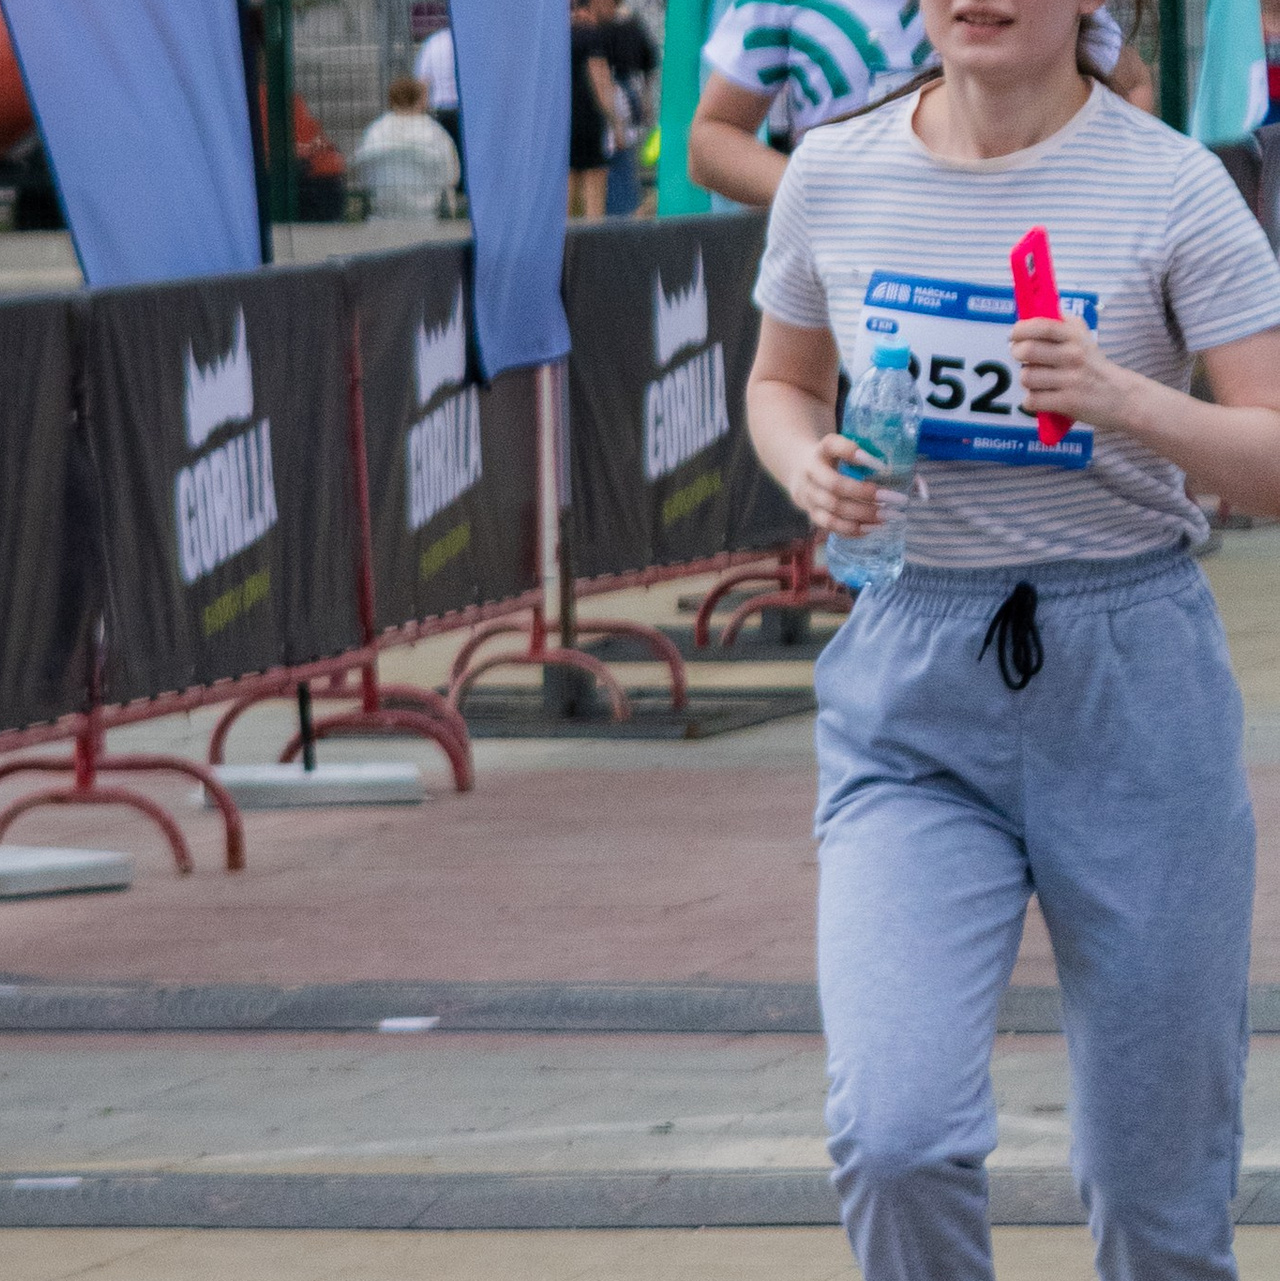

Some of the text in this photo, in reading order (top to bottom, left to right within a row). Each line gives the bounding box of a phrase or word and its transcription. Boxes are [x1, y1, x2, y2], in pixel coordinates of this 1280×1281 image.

[646, 341, 730, 482] GORILLA
[910, 354, 1038, 416] 52
[176, 418, 278, 586] GORILLA
